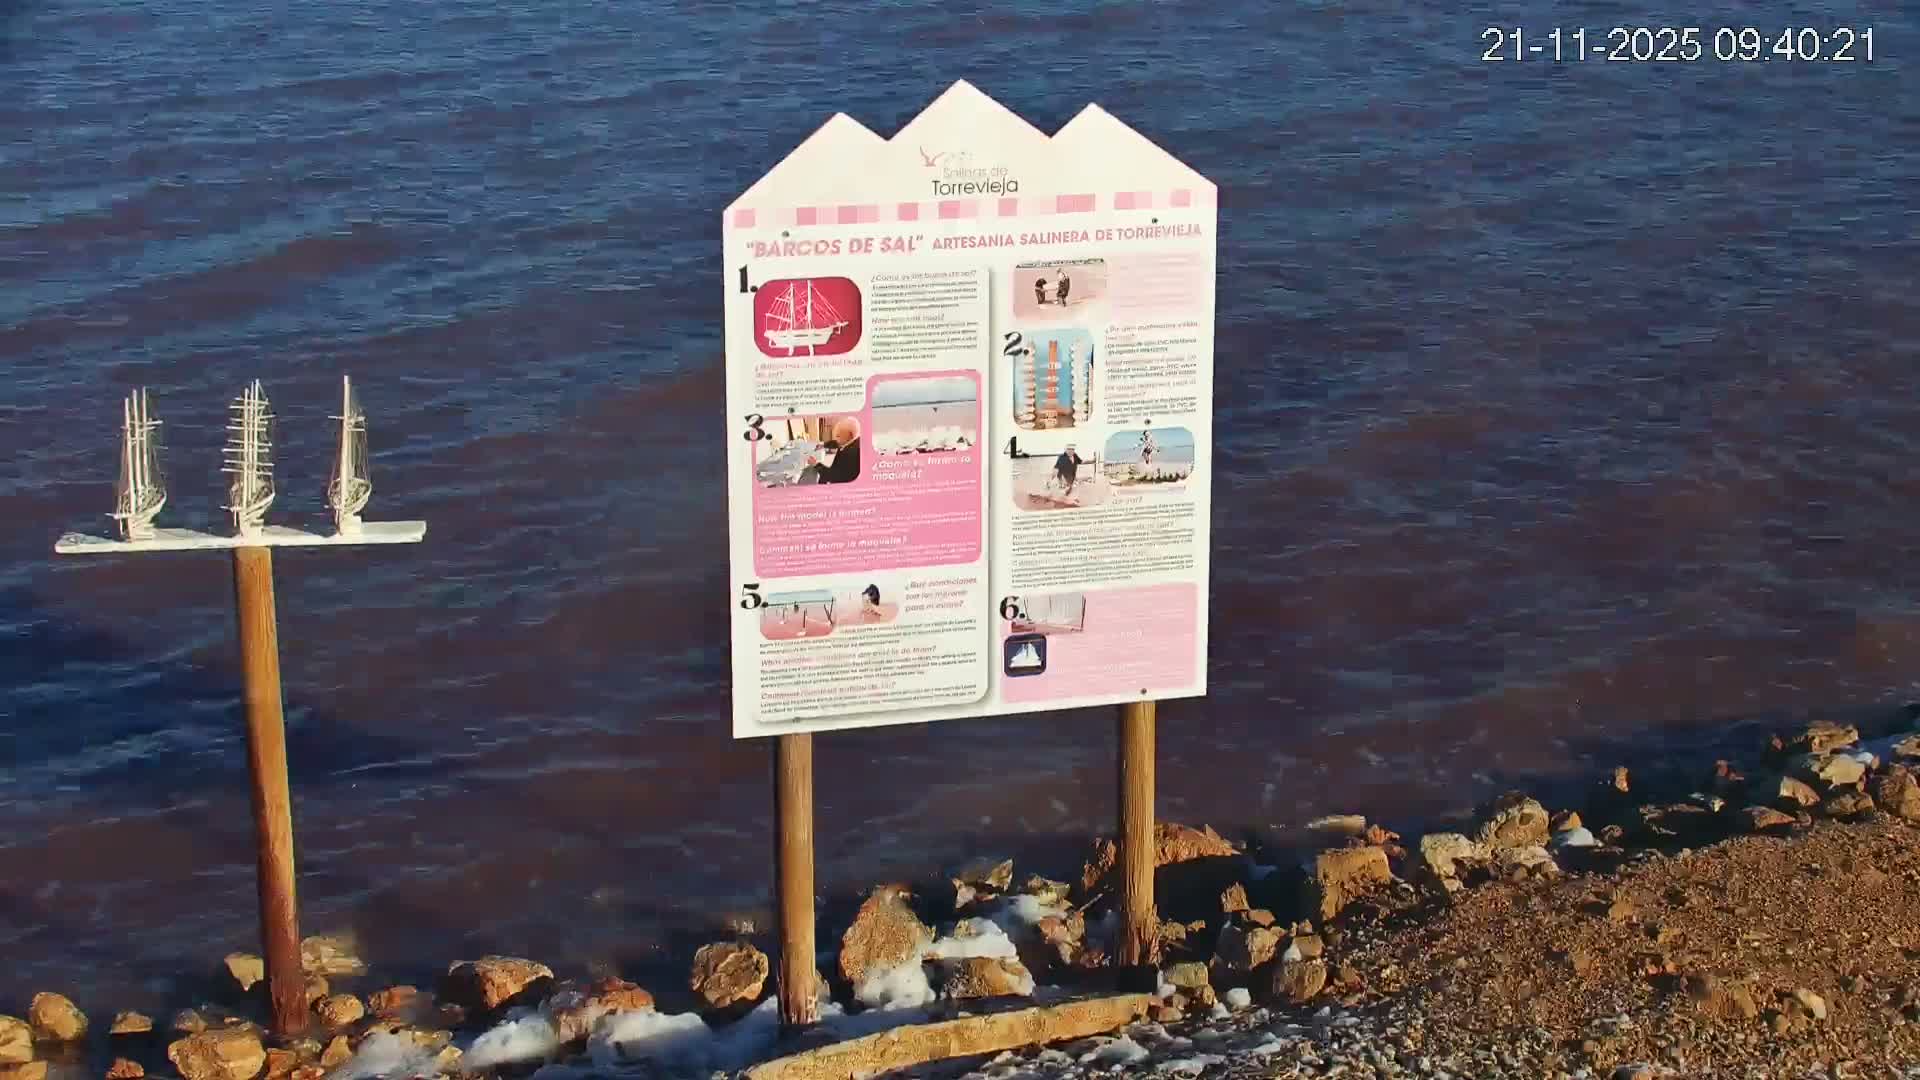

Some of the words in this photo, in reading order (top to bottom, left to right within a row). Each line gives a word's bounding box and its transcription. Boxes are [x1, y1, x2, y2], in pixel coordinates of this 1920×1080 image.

[932, 177, 1018, 196] Torrevieja
[849, 237, 874, 254] DE
[932, 234, 1015, 250] ARTESANIA
[1019, 230, 1089, 246] SALINERA
[1095, 228, 1113, 241] DE
[1116, 223, 1202, 241] TORREVIEJA
[739, 264, 758, 293] 1.
[1003, 331, 1030, 357] 2.
[743, 414, 773, 441] 3.
[1003, 436, 1030, 459] 4.
[741, 583, 769, 610] 5.
[1000, 596, 1026, 620] 6.
